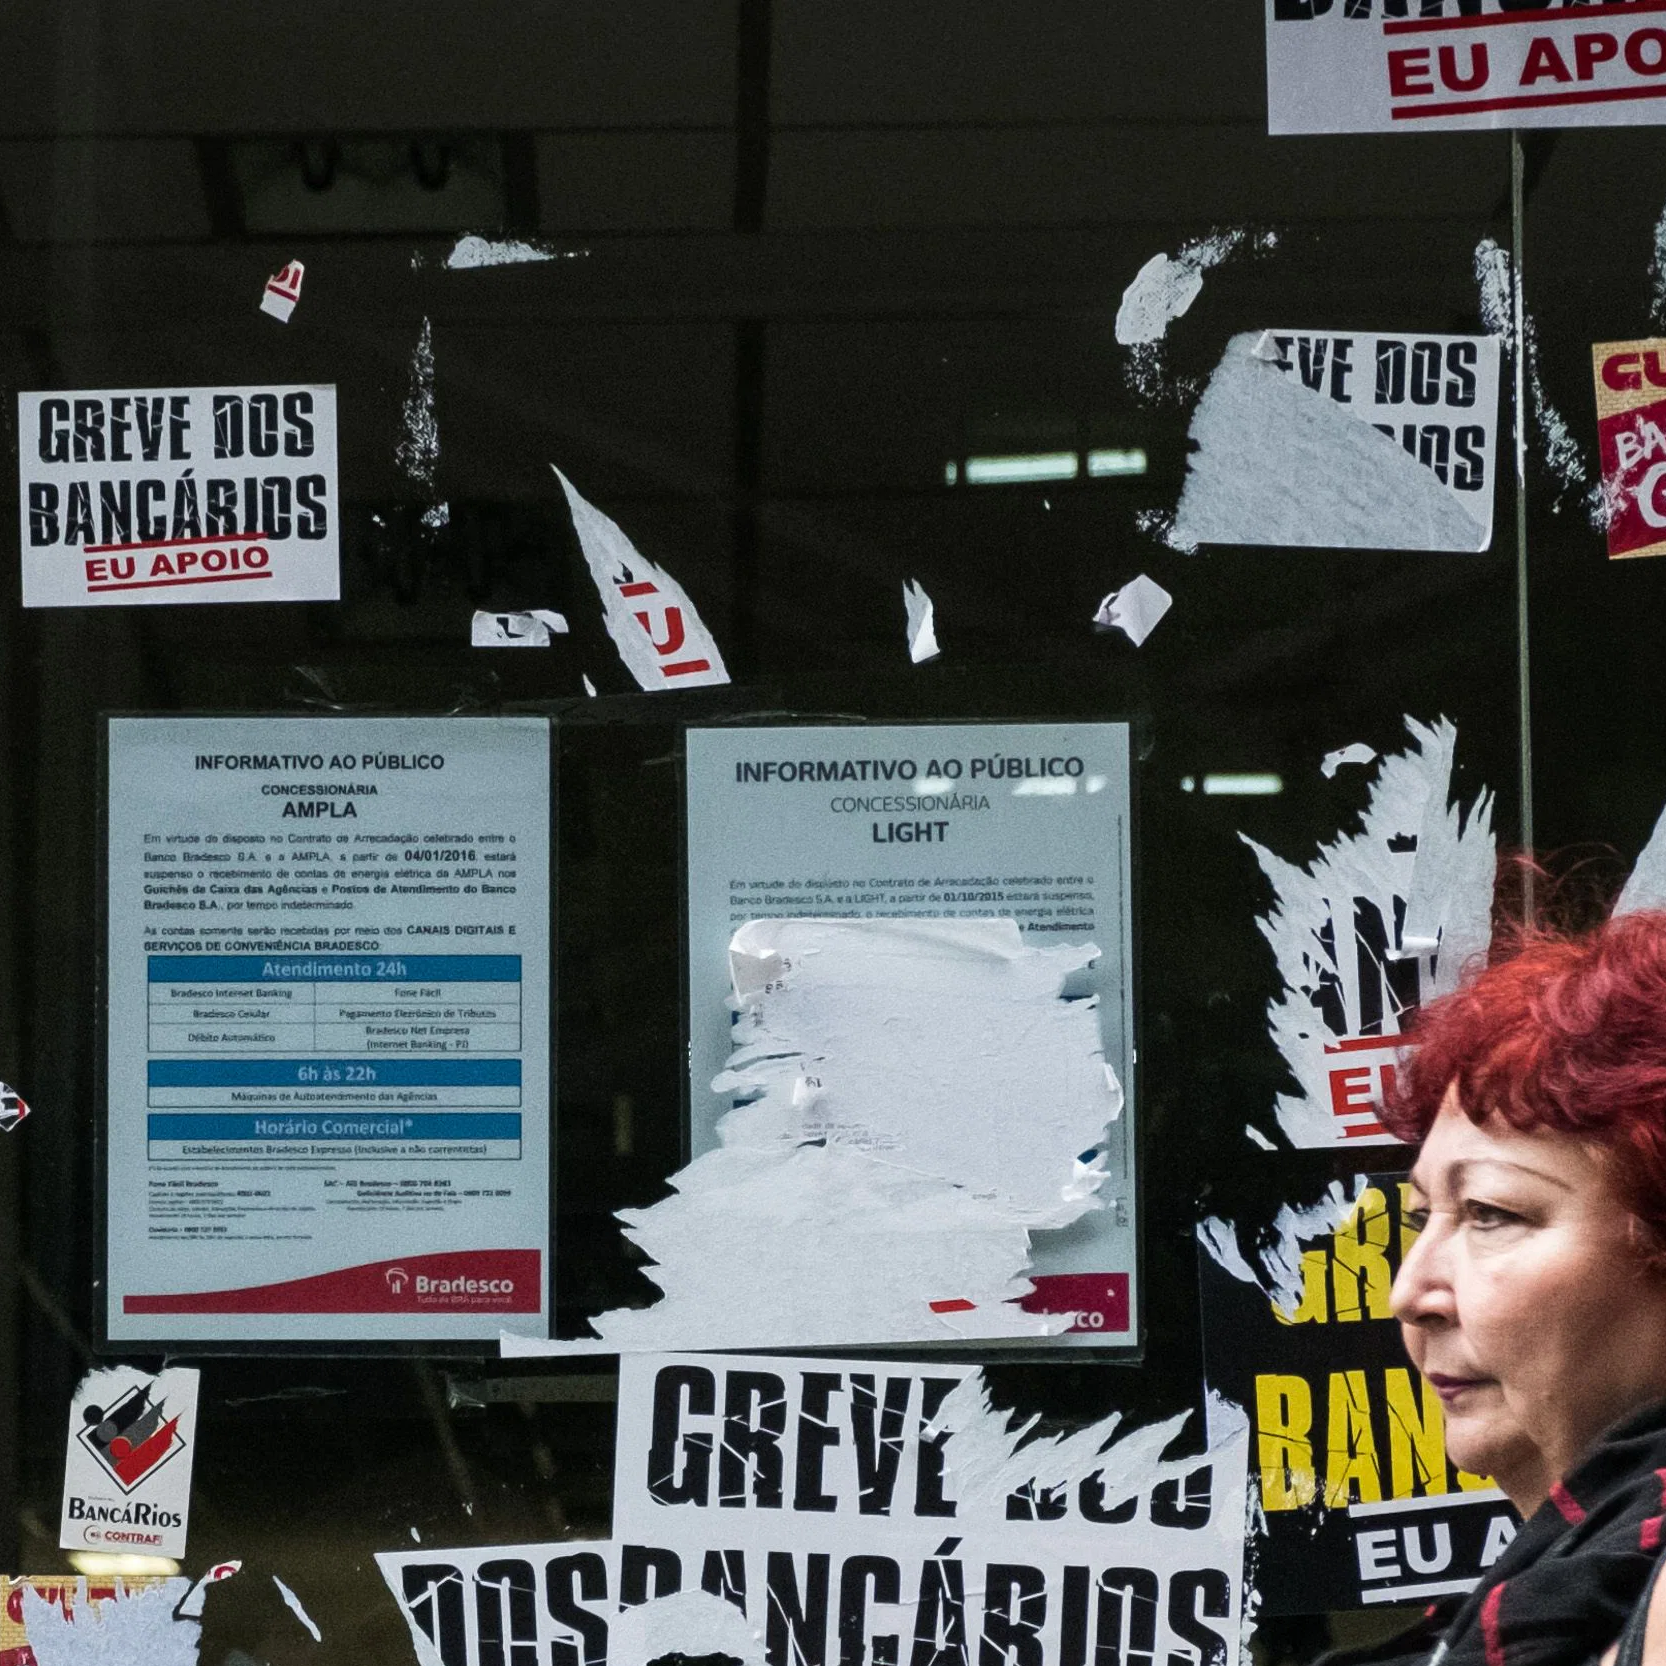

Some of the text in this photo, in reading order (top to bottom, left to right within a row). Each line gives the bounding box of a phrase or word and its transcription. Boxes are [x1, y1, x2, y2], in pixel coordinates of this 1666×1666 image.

[1387, 42, 1489, 97] EU
[1375, 339, 1477, 407] DOS
[39, 392, 314, 463] GREVE DOS
[29, 468, 327, 546] BANCÁRIOS
[85, 546, 269, 581] EU APOIO
[194, 751, 445, 770] INFORMATIVO AO PÚBLICO
[735, 753, 1084, 783] INFORMATIVO AO PÚBLICO
[261, 782, 378, 796] CONCESSIONÁRIA
[282, 801, 357, 818] AMPLA
[831, 792, 991, 813] CONCESSIONÁRIA
[873, 821, 949, 844] LIGHT
[262, 961, 407, 978] Atendimento 24h
[298, 1065, 377, 1082] 6h às 22h
[255, 1119, 317, 1135] Horário
[416, 1276, 514, 1294] Bradesco
[1354, 1522, 1452, 1581] EU
